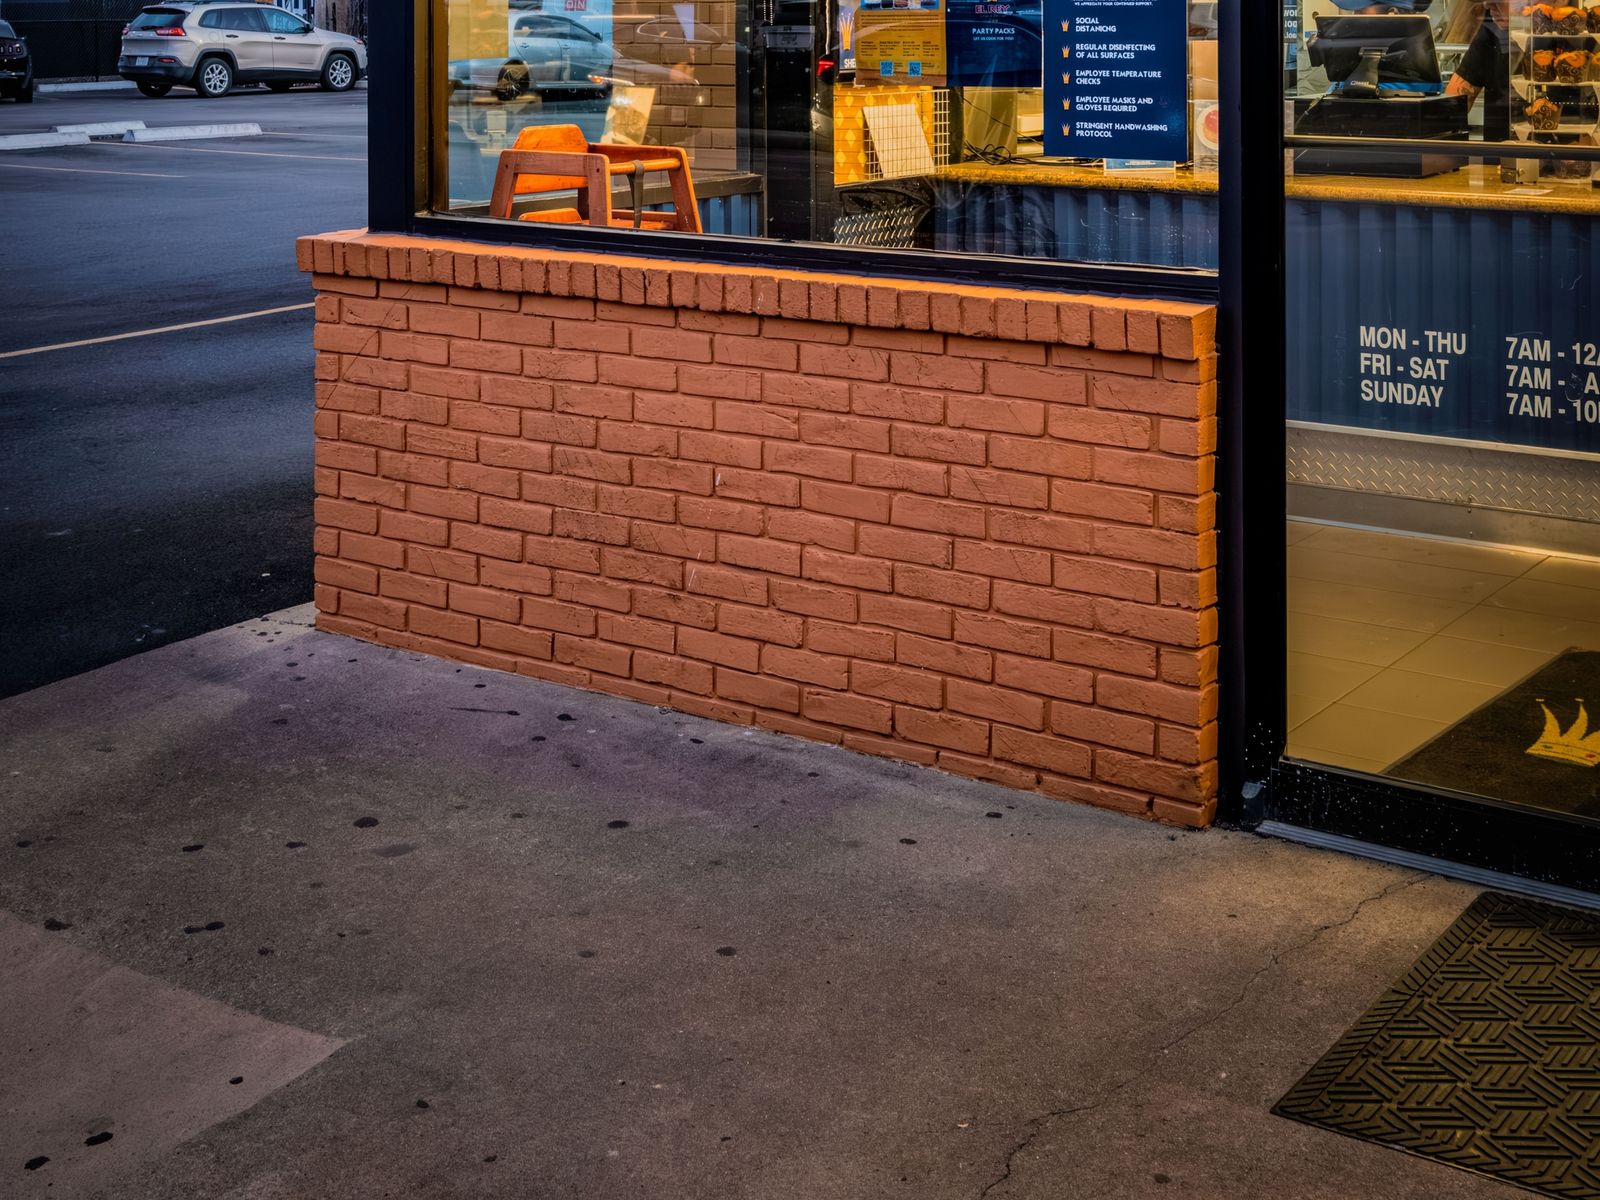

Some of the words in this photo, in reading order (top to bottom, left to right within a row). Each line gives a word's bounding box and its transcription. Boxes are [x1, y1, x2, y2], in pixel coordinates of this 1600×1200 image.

[1111, 70, 1162, 78] TEMPERATURE
[1114, 123, 1168, 131] HANDWASHING
[1360, 326, 1406, 350] MON
[1424, 330, 1467, 355] THU
[1505, 337, 1550, 362] 7AM
[1572, 342, 1600, 366] 12
[1360, 353, 1391, 376] FRI
[1410, 357, 1449, 380] SAT
[1506, 365, 1551, 390] 7AM
[1361, 380, 1444, 407] SUNDAY
[1506, 393, 1551, 418] 7AM
[1573, 399, 1600, 423] 10
